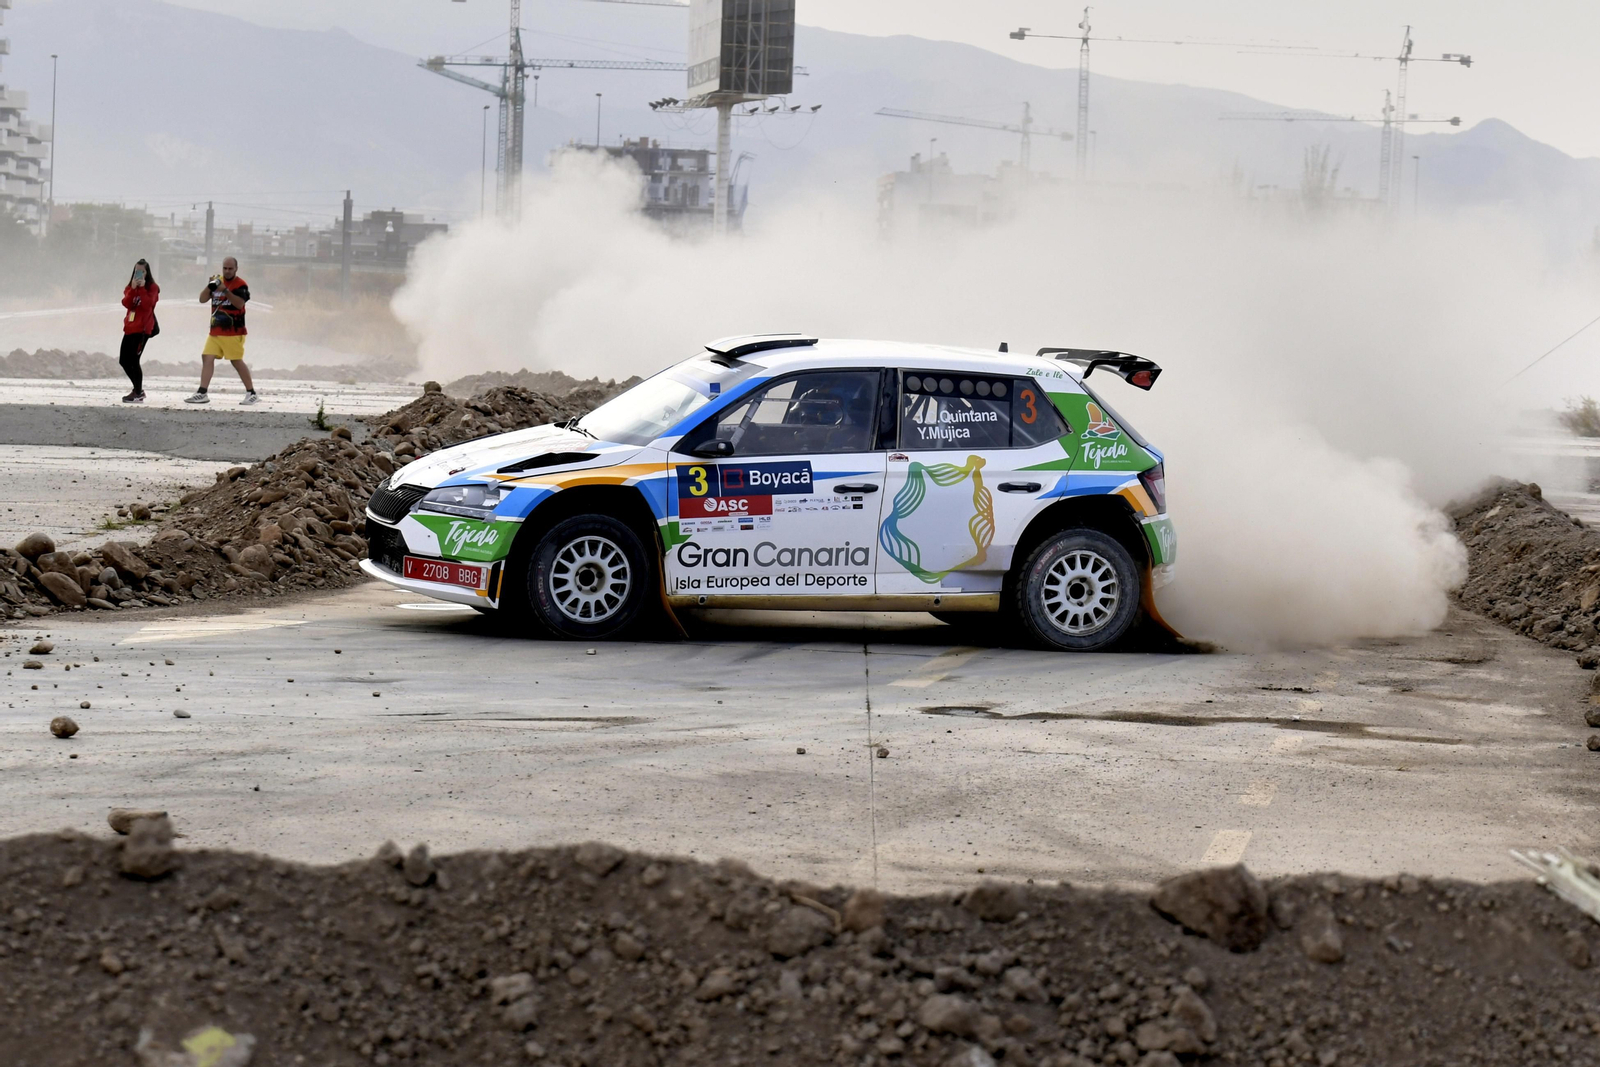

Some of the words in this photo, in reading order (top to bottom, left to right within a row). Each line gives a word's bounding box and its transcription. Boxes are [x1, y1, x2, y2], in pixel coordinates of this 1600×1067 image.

[1020, 389, 1038, 424] 3
[917, 425, 971, 442] Y.Mujica
[1081, 441, 1128, 469] Tejeda
[688, 466, 709, 496] 3
[748, 468, 811, 488] Boyacá
[717, 499, 749, 512] ASC
[444, 520, 500, 556] Tejeda
[677, 541, 749, 568] Gran
[753, 541, 870, 567] Canaria
[406, 560, 413, 574] V
[423, 563, 449, 579] 2708
[458, 568, 478, 584] BBG
[675, 576, 701, 589] Isla
[706, 575, 770, 590] Europea
[775, 573, 799, 587] del
[804, 573, 868, 590] Deporte
